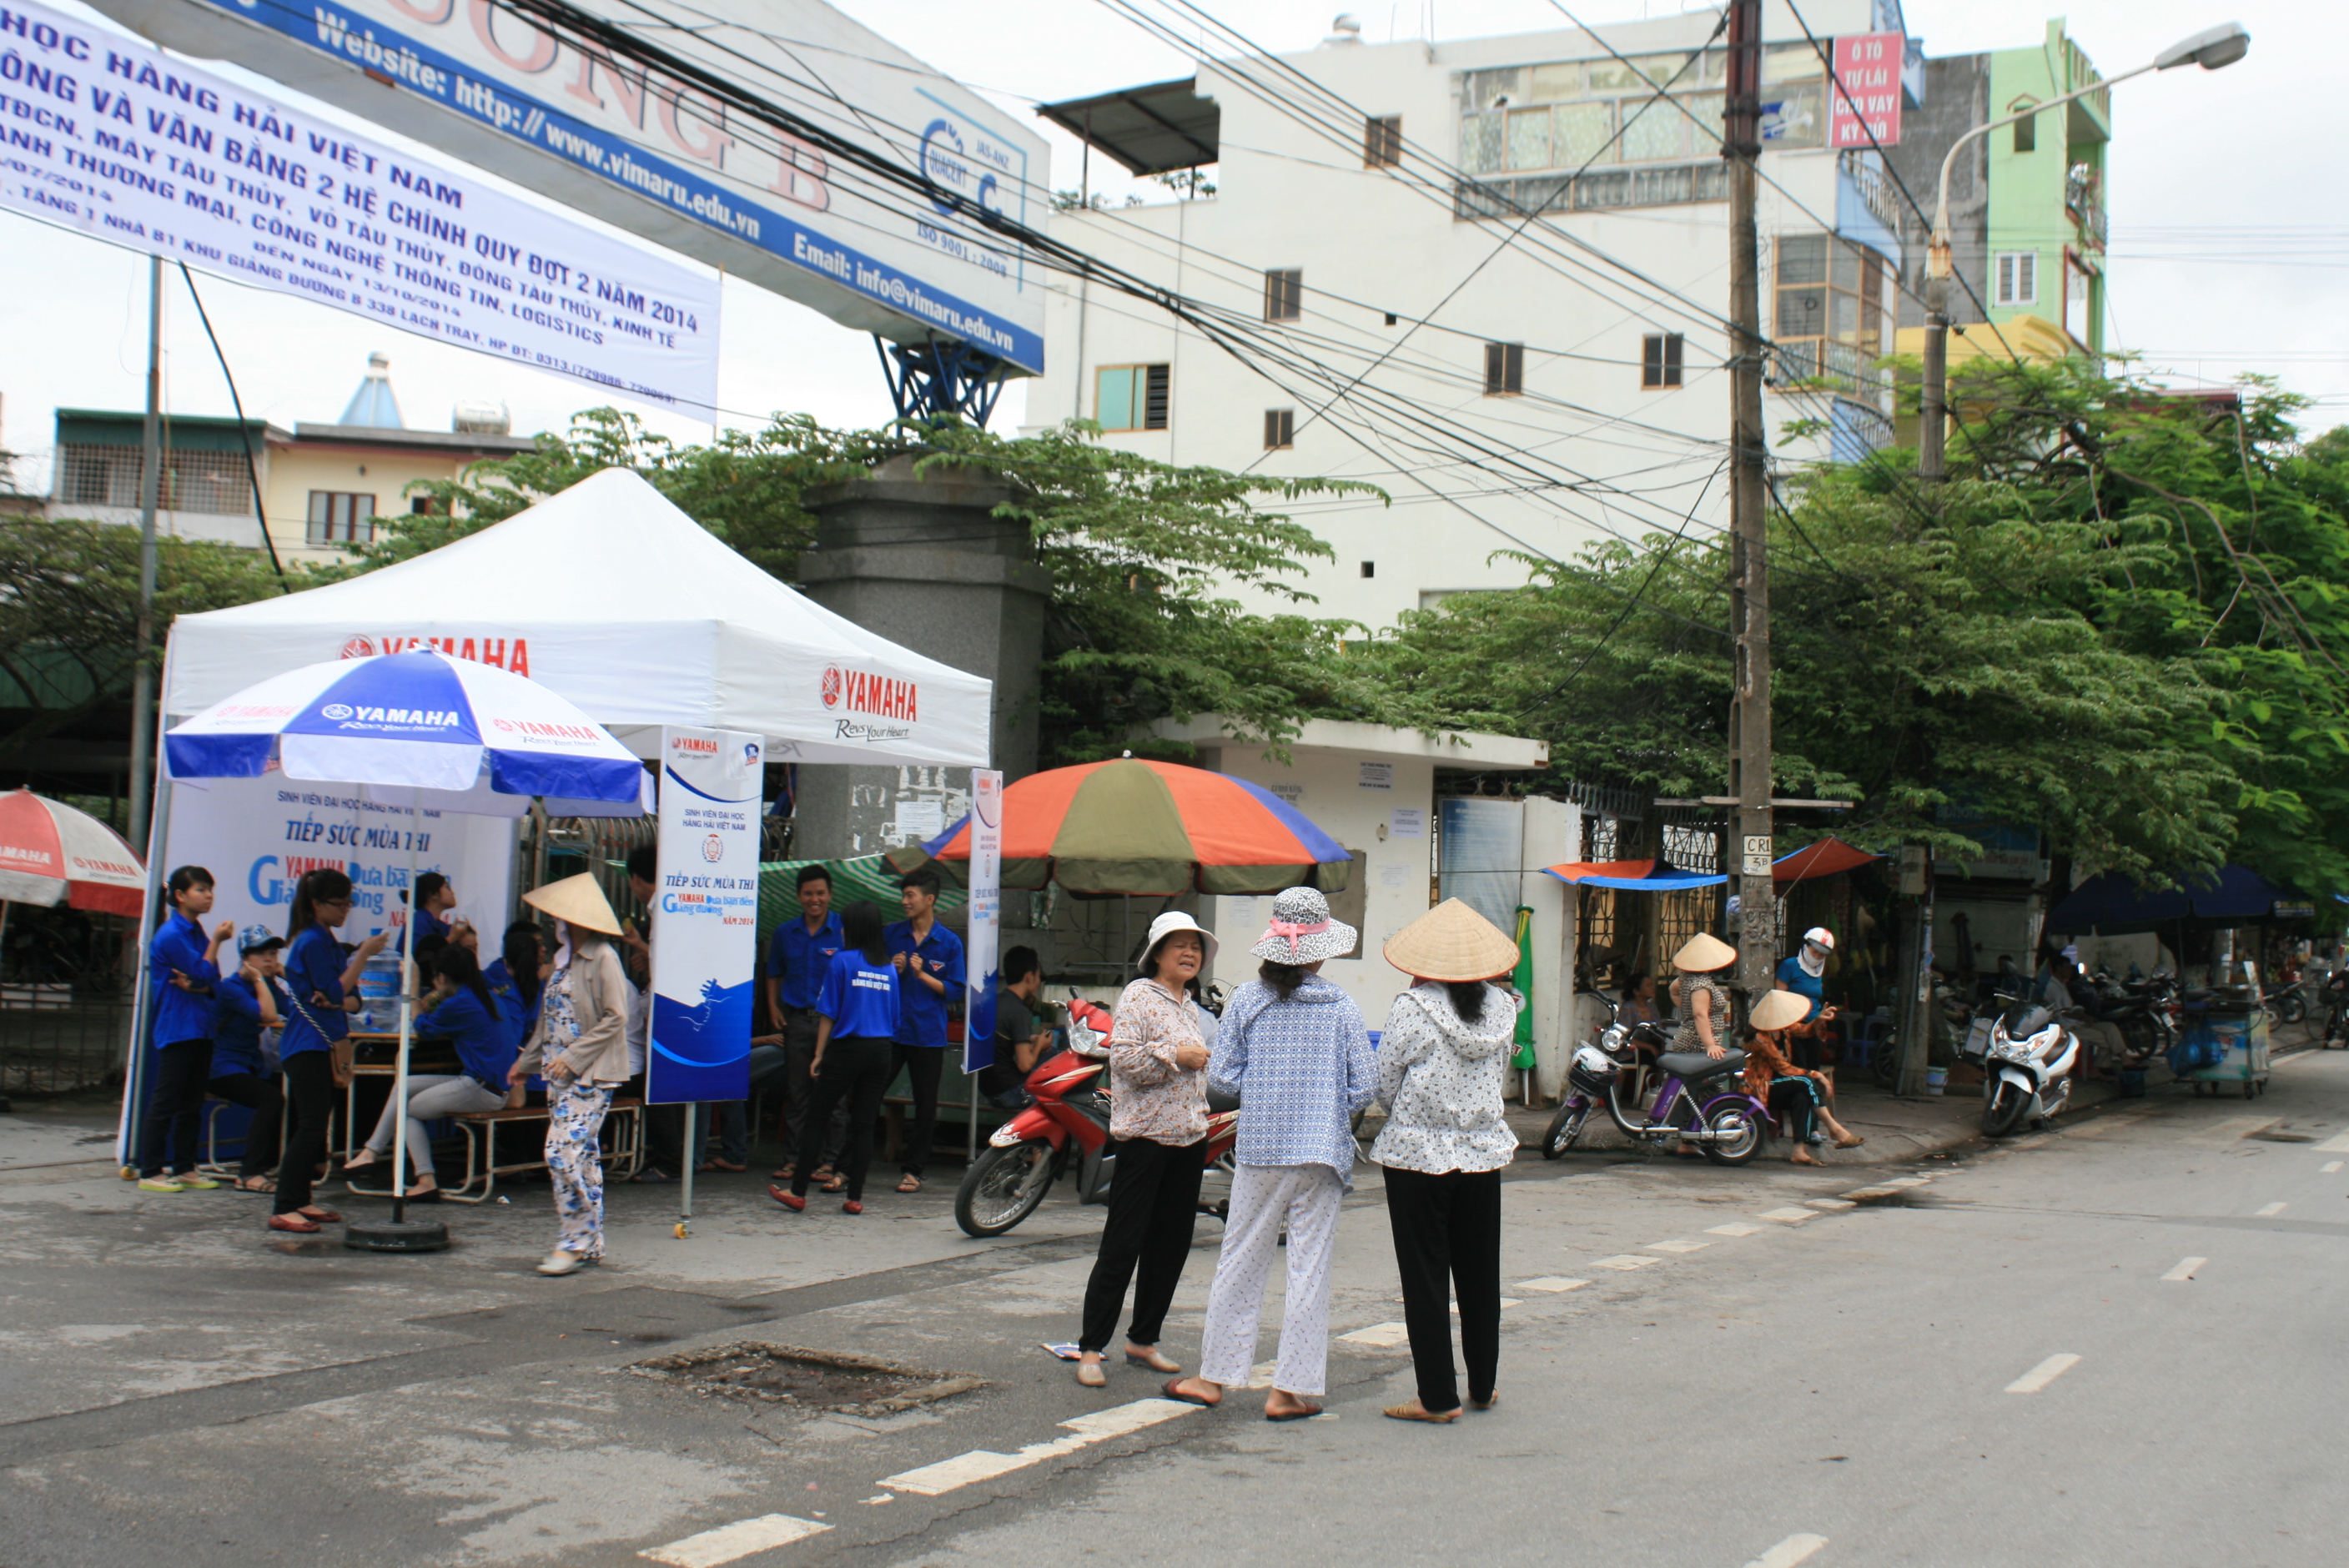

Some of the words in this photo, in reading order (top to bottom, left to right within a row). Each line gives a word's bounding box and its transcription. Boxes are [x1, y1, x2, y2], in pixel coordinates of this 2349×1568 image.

[314, 7, 448, 95] Website:
[1, 8, 90, 63] HỌC
[106, 50, 220, 115] HÀNG
[234, 100, 295, 143] HẢI
[307, 130, 379, 175] VIỆT
[388, 163, 464, 209] NAM
[1867, 93, 1895, 113] VAY
[90, 85, 134, 125] VÀ
[147, 107, 214, 154] VĂN
[224, 135, 307, 189] BẰNG
[316, 173, 334, 199] 2
[342, 181, 378, 219] HỆ
[386, 199, 466, 249] CHÍNH
[475, 233, 521, 267] QUY
[527, 253, 571, 287] ĐỢT
[576, 272, 591, 294] 2
[596, 278, 646, 314] NĂM
[651, 299, 698, 334] 2014
[166, 152, 216, 186] TÀU
[345, 217, 387, 248] TÀU
[518, 280, 553, 305] TÀU
[612, 314, 652, 341] KINH
[917, 224, 938, 244] ISO
[940, 234, 968, 261] 9001
[86, 207, 95, 220] 1
[152, 228, 175, 247] B1
[183, 238, 221, 260] KHU
[350, 292, 362, 305] B
[367, 298, 395, 316] 338
[400, 309, 440, 330] LẠCH
[488, 336, 507, 350] HP
[250, 212, 318, 249] CÔNG
[324, 238, 385, 274] NGHỆ
[391, 259, 462, 298] THÔNG
[511, 302, 605, 346] LOGISTICS
[794, 231, 852, 281] Email:
[856, 261, 1014, 353] info@vimaru.edu.vn
[381, 637, 530, 678] YAHA
[845, 669, 918, 722] YAMAHA
[355, 706, 459, 726] YAMAHA
[511, 720, 601, 741] YAMAHA
[682, 737, 717, 753] YAMAHA
[277, 790, 299, 803] SINH
[301, 792, 324, 807] VIÊN
[684, 808, 701, 817] SINH
[285, 812, 324, 842] TIẾP
[326, 817, 359, 847] SỨC
[364, 824, 400, 850] MÙA
[731, 822, 746, 831] NAM
[83, 857, 138, 877] YAMAHA
[666, 870, 689, 887] TIẾP
[738, 879, 755, 890] THI
[677, 893, 705, 903] YAMAHA
[738, 917, 754, 925] 2014
